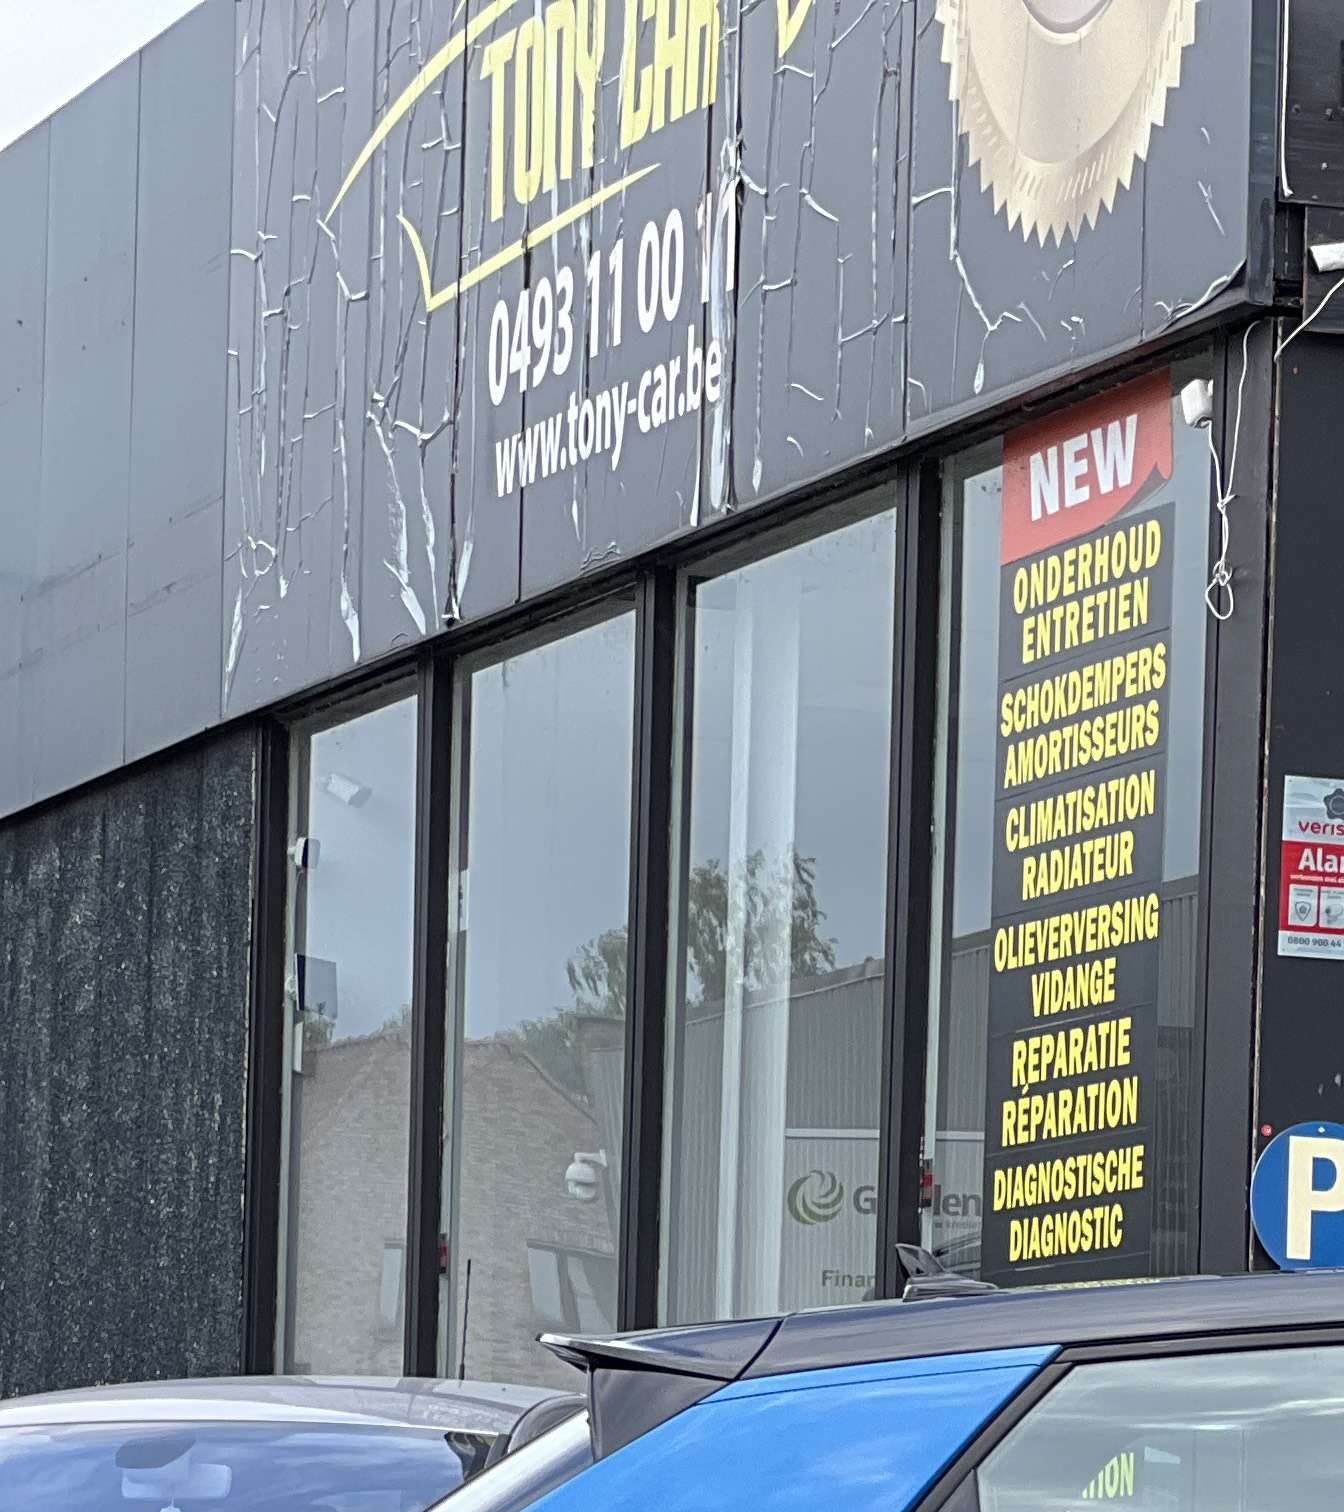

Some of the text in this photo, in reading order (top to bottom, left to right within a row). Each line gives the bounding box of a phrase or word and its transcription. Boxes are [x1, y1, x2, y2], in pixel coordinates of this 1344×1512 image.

[480, 0, 605, 222] TONY
[488, 265, 574, 406] 0493
[586, 237, 624, 359] 11
[637, 208, 685, 333] 00
[495, 324, 722, 498] www.tony-car.be
[1030, 414, 1139, 521] NEW
[1014, 519, 1161, 614] ONDERHOUD
[1022, 577, 1149, 665] ENTRETIEN
[1001, 643, 1166, 738] SCHOKDEMPERS
[1003, 700, 1160, 789] AMORTISSEURS
[1005, 769, 1156, 852] CLIMATISATION
[1022, 831, 1134, 900] RADIATEUR
[994, 893, 1159, 972] OLIEVERVERSING
[1031, 957, 1116, 1017] VIDANGE
[1011, 1017, 1132, 1088] REPARATIE
[1002, 1076, 1138, 1147] RÉPARATION
[993, 1145, 1145, 1212] DIAGNOSTISCHE
[1009, 1204, 1123, 1262] DIAGNOSTIC
[1082, 1452, 1134, 1499] ION
